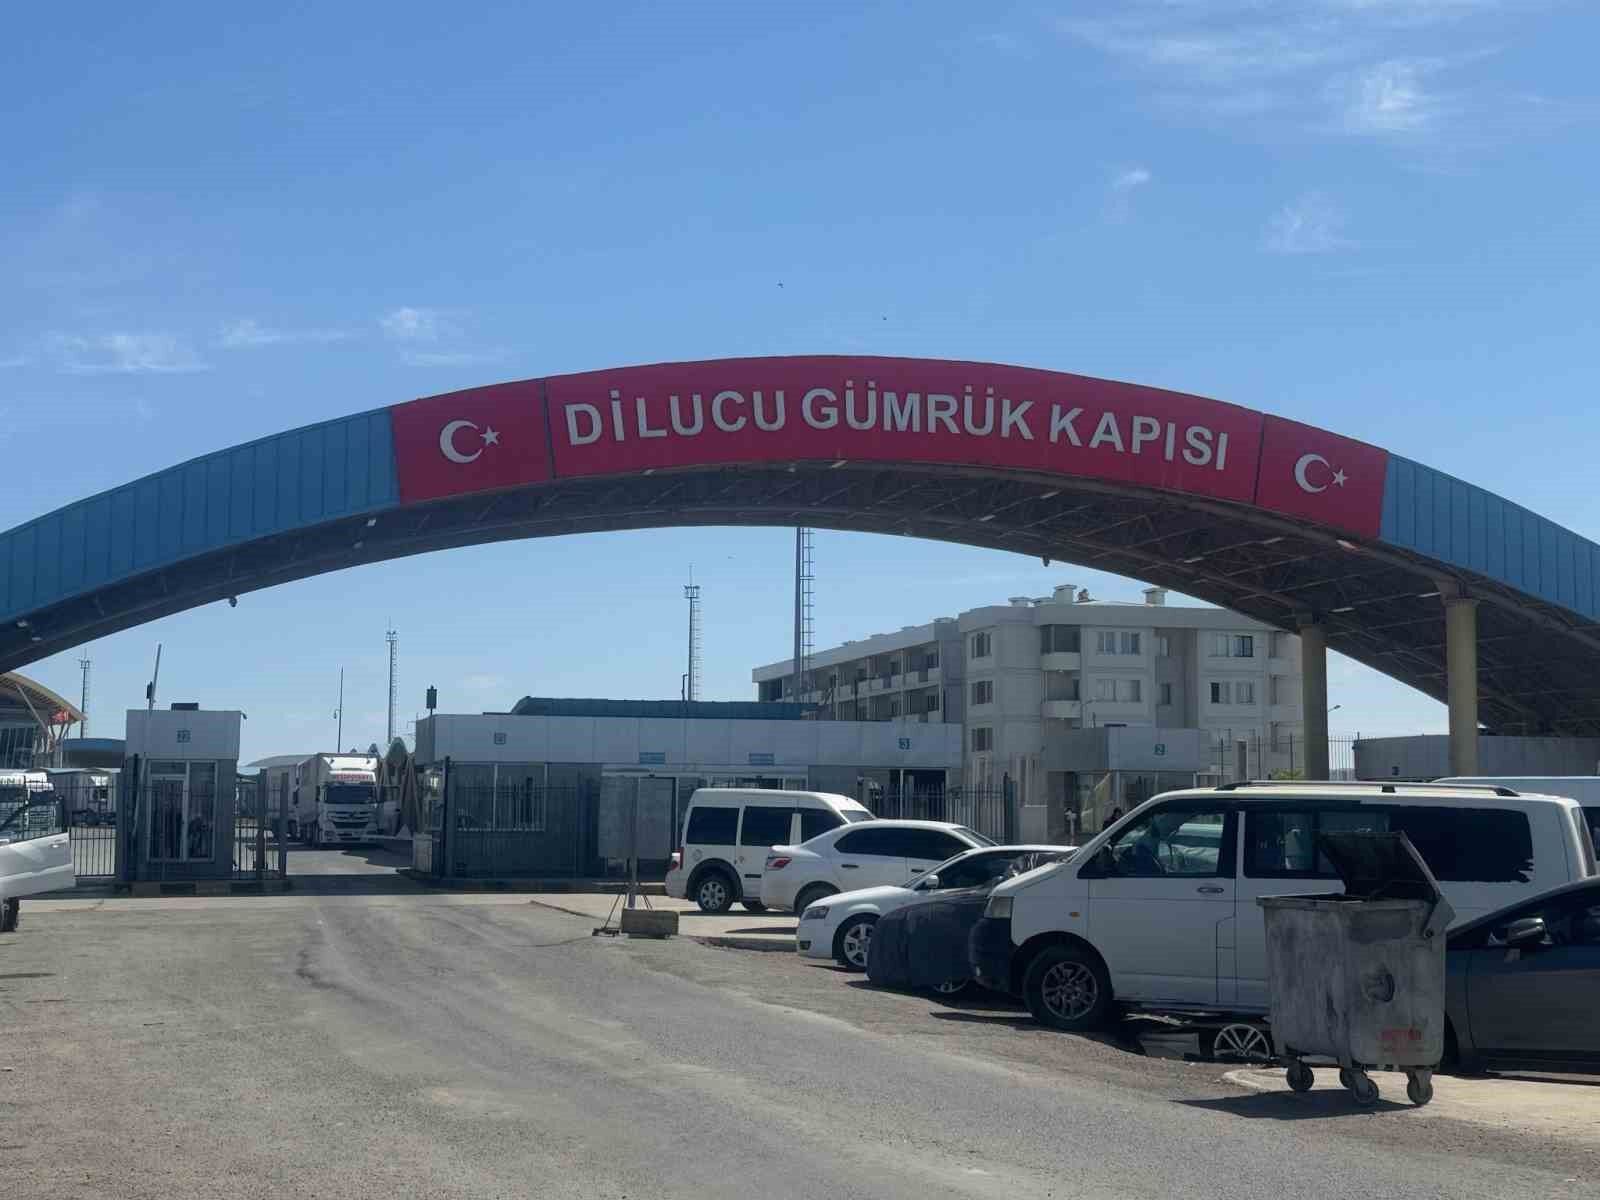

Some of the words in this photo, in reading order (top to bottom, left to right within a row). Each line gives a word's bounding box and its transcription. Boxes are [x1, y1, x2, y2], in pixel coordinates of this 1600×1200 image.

[563, 389, 787, 446] DİLUCU
[800, 379, 1035, 441] GÜMRÜK
[1048, 403, 1230, 471] KAPISI
